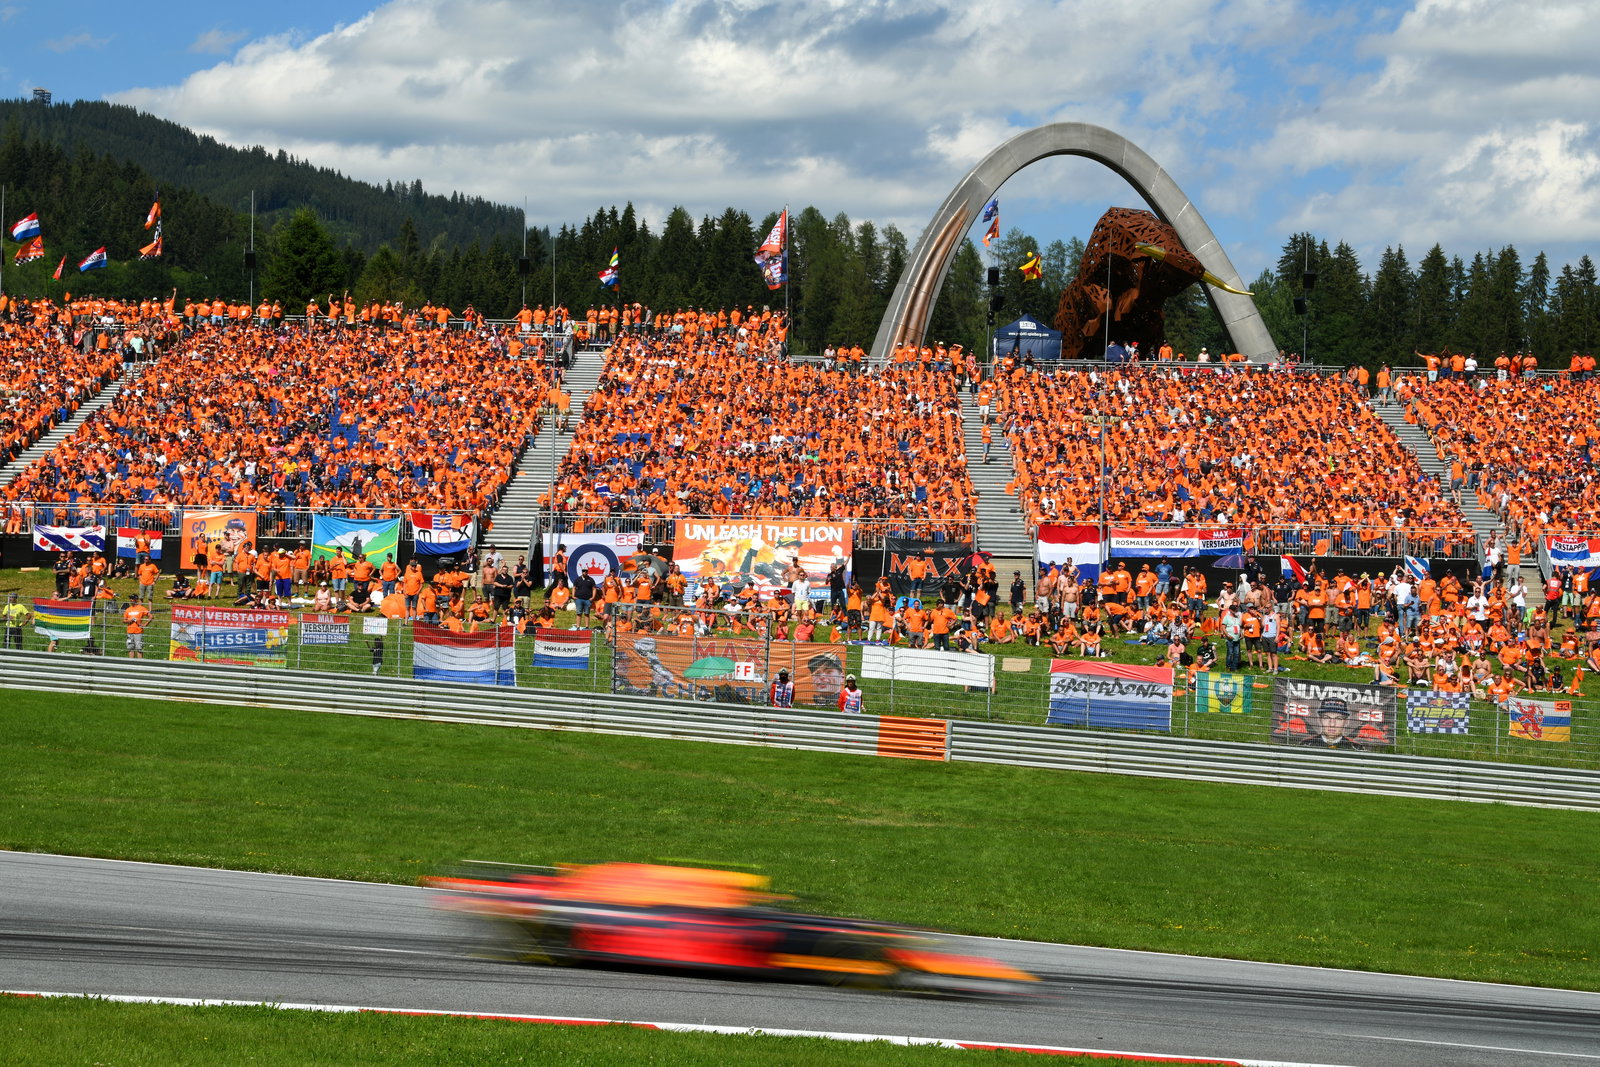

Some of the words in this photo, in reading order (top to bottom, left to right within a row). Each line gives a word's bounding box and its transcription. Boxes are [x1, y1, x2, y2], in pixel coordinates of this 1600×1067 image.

[192, 520, 206, 533] GO
[684, 523, 762, 541] UNLEASH
[765, 525, 798, 541] THE
[801, 526, 843, 543] LION
[616, 534, 639, 546] 33
[1201, 539, 1242, 549] VERSTAPPEN
[174, 609, 202, 619] MAX
[206, 611, 288, 624] VERSTAPPEN
[318, 615, 334, 623] MAX
[304, 623, 348, 634] VERSTAPPEN
[544, 645, 578, 654] HOLLAND
[693, 641, 764, 669] MAX
[1284, 703, 1311, 717] 33
[1556, 702, 1570, 710] 33
[1357, 710, 1385, 722] 33
